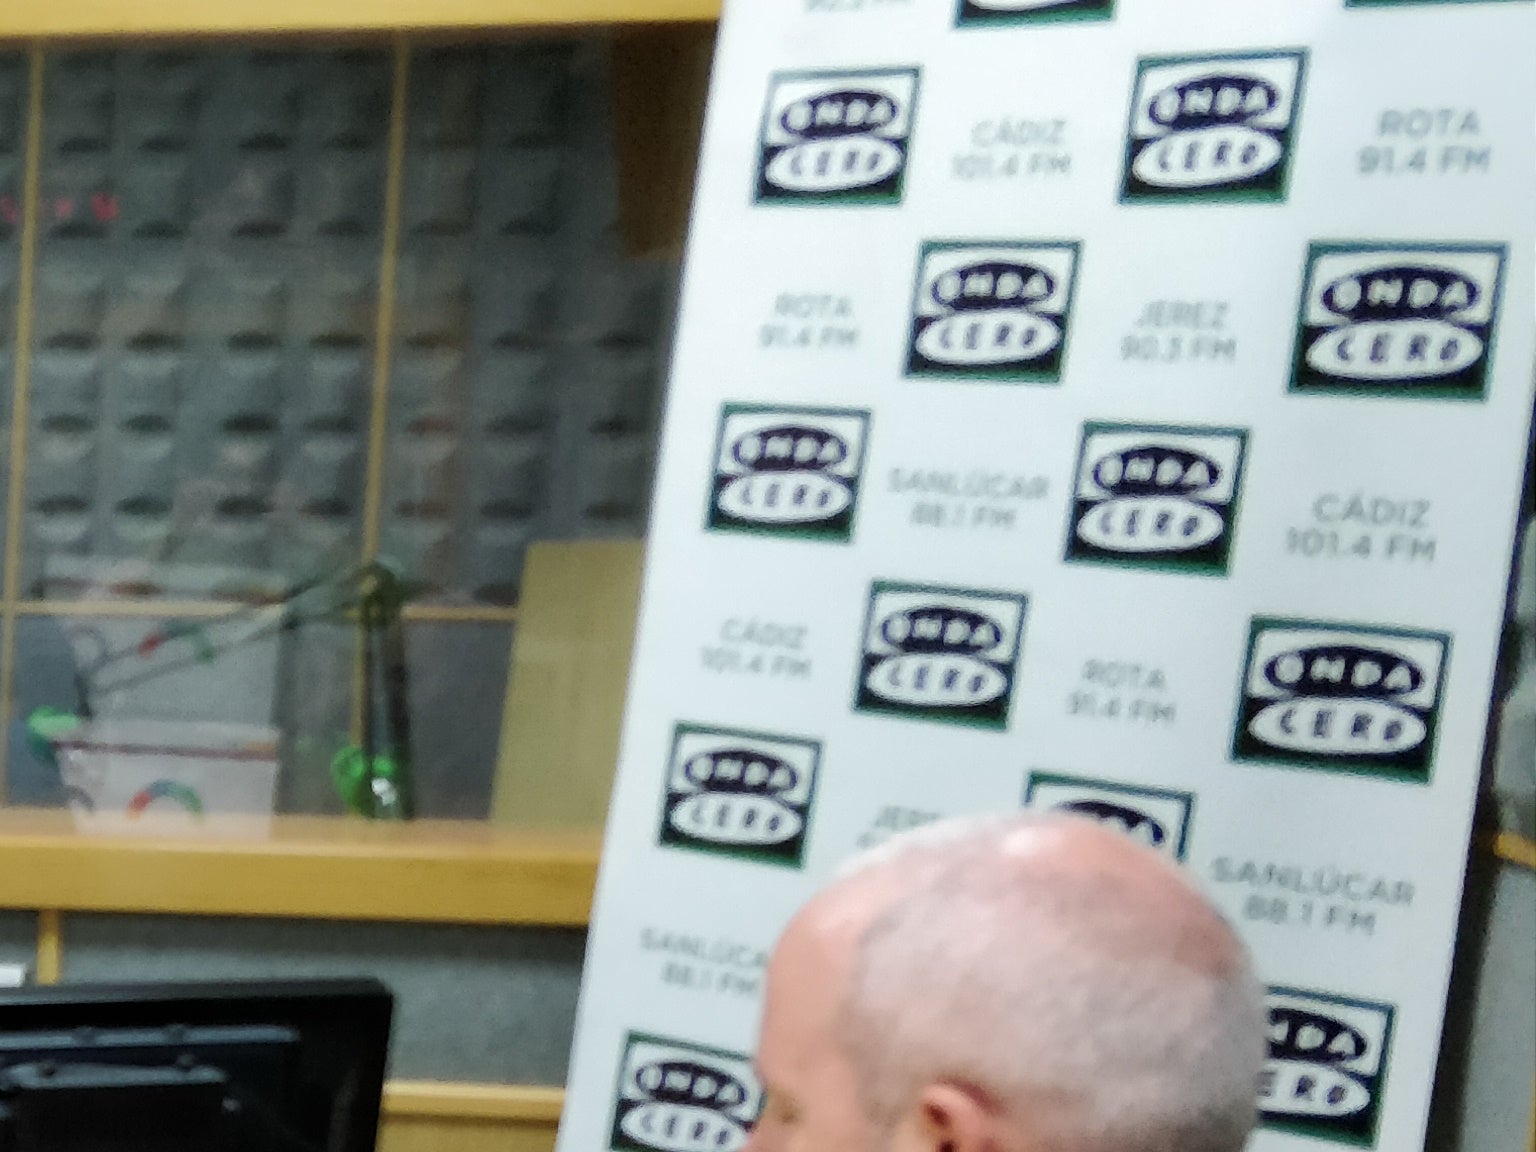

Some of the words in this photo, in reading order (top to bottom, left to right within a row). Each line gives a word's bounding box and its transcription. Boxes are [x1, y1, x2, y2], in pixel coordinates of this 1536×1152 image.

[787, 99, 897, 130] ONDA
[1153, 86, 1271, 121] ONDA
[971, 117, 1066, 146] CÁDIZ
[1378, 109, 1479, 135] ROTA
[790, 151, 881, 176] CERO
[1027, 152, 1071, 176] FM
[1159, 141, 1258, 172] CERO
[1356, 145, 1427, 175] 91.4
[1441, 146, 1491, 173] FM
[936, 273, 1050, 302] ONDA
[1332, 278, 1468, 311] ONDA
[775, 293, 853, 318] ROTA
[1135, 299, 1228, 328] JEREZ
[820, 325, 858, 348] FM
[940, 323, 1036, 350] CERO
[1190, 336, 1236, 361] FM
[1337, 333, 1458, 362] CERO
[737, 436, 843, 462] ONDA
[1098, 454, 1210, 487] ONDA
[741, 483, 830, 506] CERO
[1313, 488, 1429, 528] CÁDIZ
[972, 506, 1015, 530] FM
[1101, 509, 1198, 537] CERO
[1286, 527, 1371, 558] 101.4
[1385, 535, 1436, 561] FM
[885, 614, 995, 645] ONDA
[770, 654, 811, 678] FM
[888, 665, 984, 692] CERO
[1082, 658, 1165, 690] ROTA
[1272, 654, 1411, 690] ONDA
[1129, 695, 1176, 722] FM
[1280, 709, 1402, 741] CERO
[688, 755, 792, 787] ONDA
[692, 804, 780, 831] CERO
[1210, 855, 1416, 905] SANLÚCAR
[1326, 904, 1376, 935] FM
[640, 1065, 740, 1103] ONDA
[1256, 1071, 1348, 1106] ERO
[643, 1112, 730, 1146] CERO
